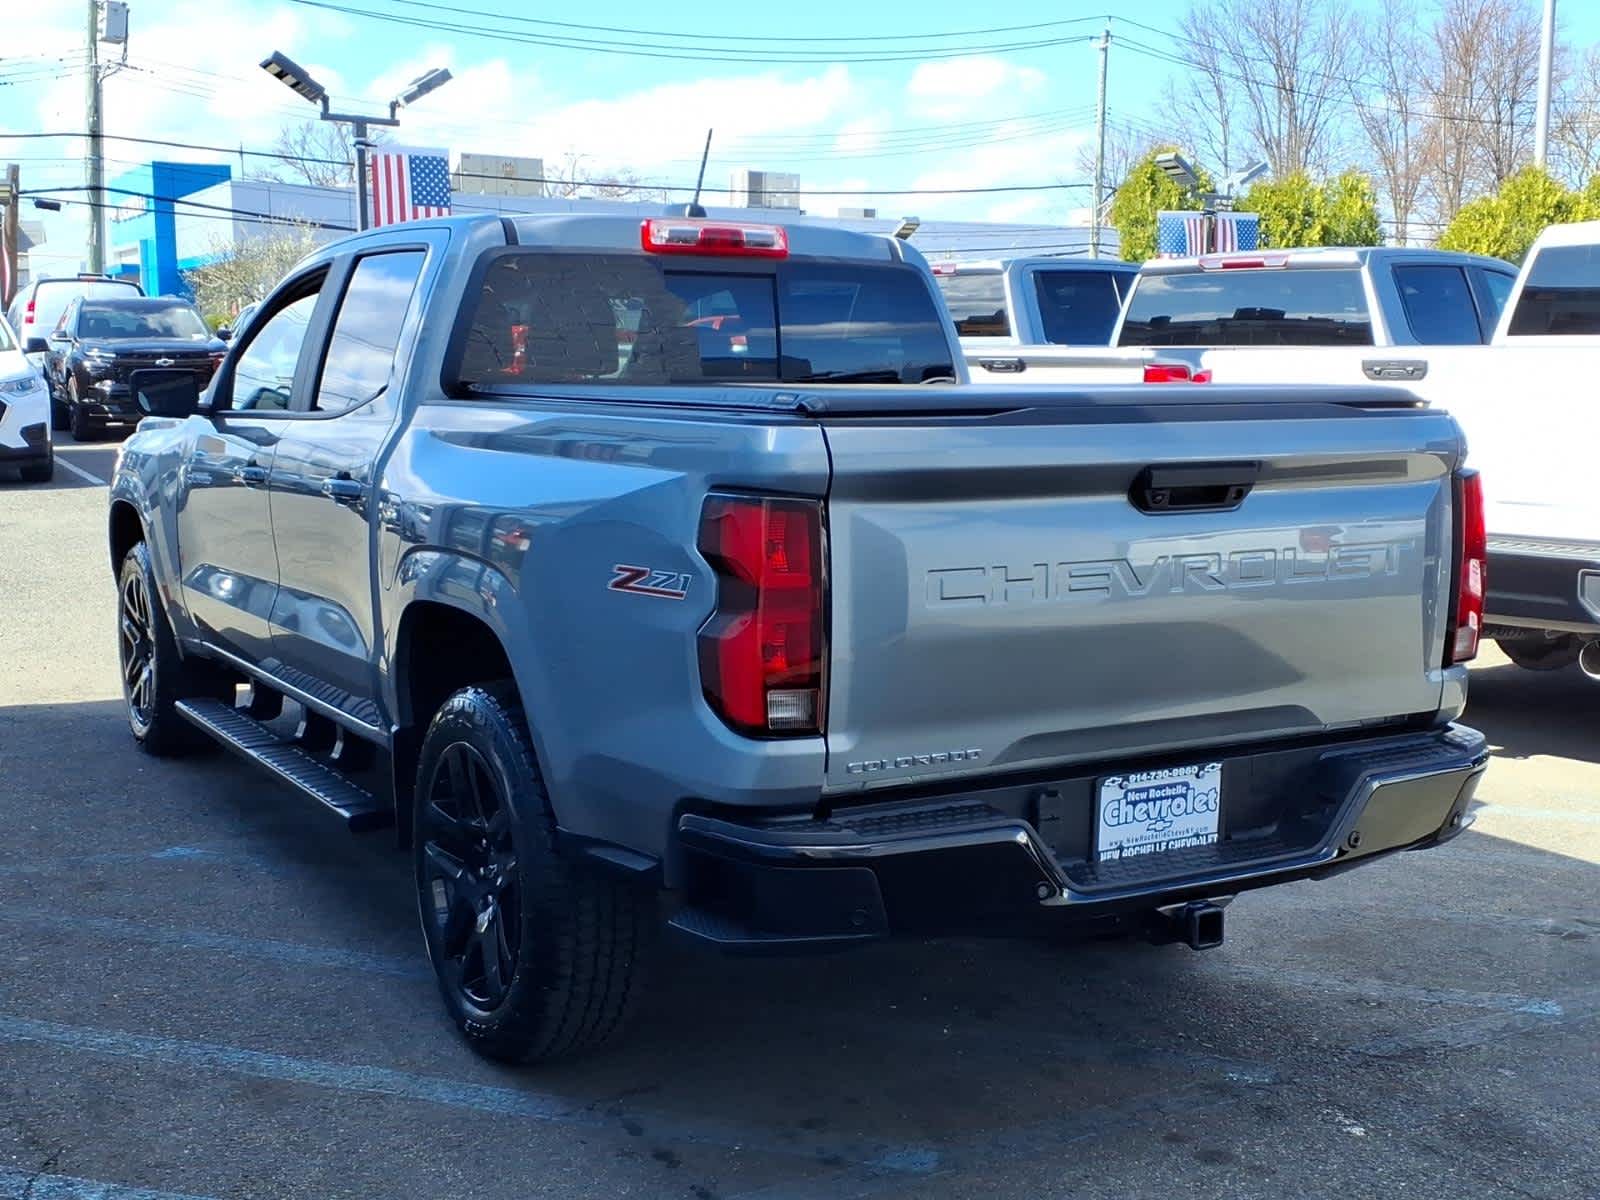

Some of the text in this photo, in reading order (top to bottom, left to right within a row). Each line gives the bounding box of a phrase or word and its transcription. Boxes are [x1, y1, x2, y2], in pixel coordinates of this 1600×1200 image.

[608, 564, 692, 600] Z71
[926, 542, 1415, 608] CHEVROLET
[847, 748, 983, 774] COLORADO
[1103, 787, 1218, 827] Chevrolet
[1127, 784, 1188, 802] New Rochelle
[1100, 850, 1121, 861] NEW
